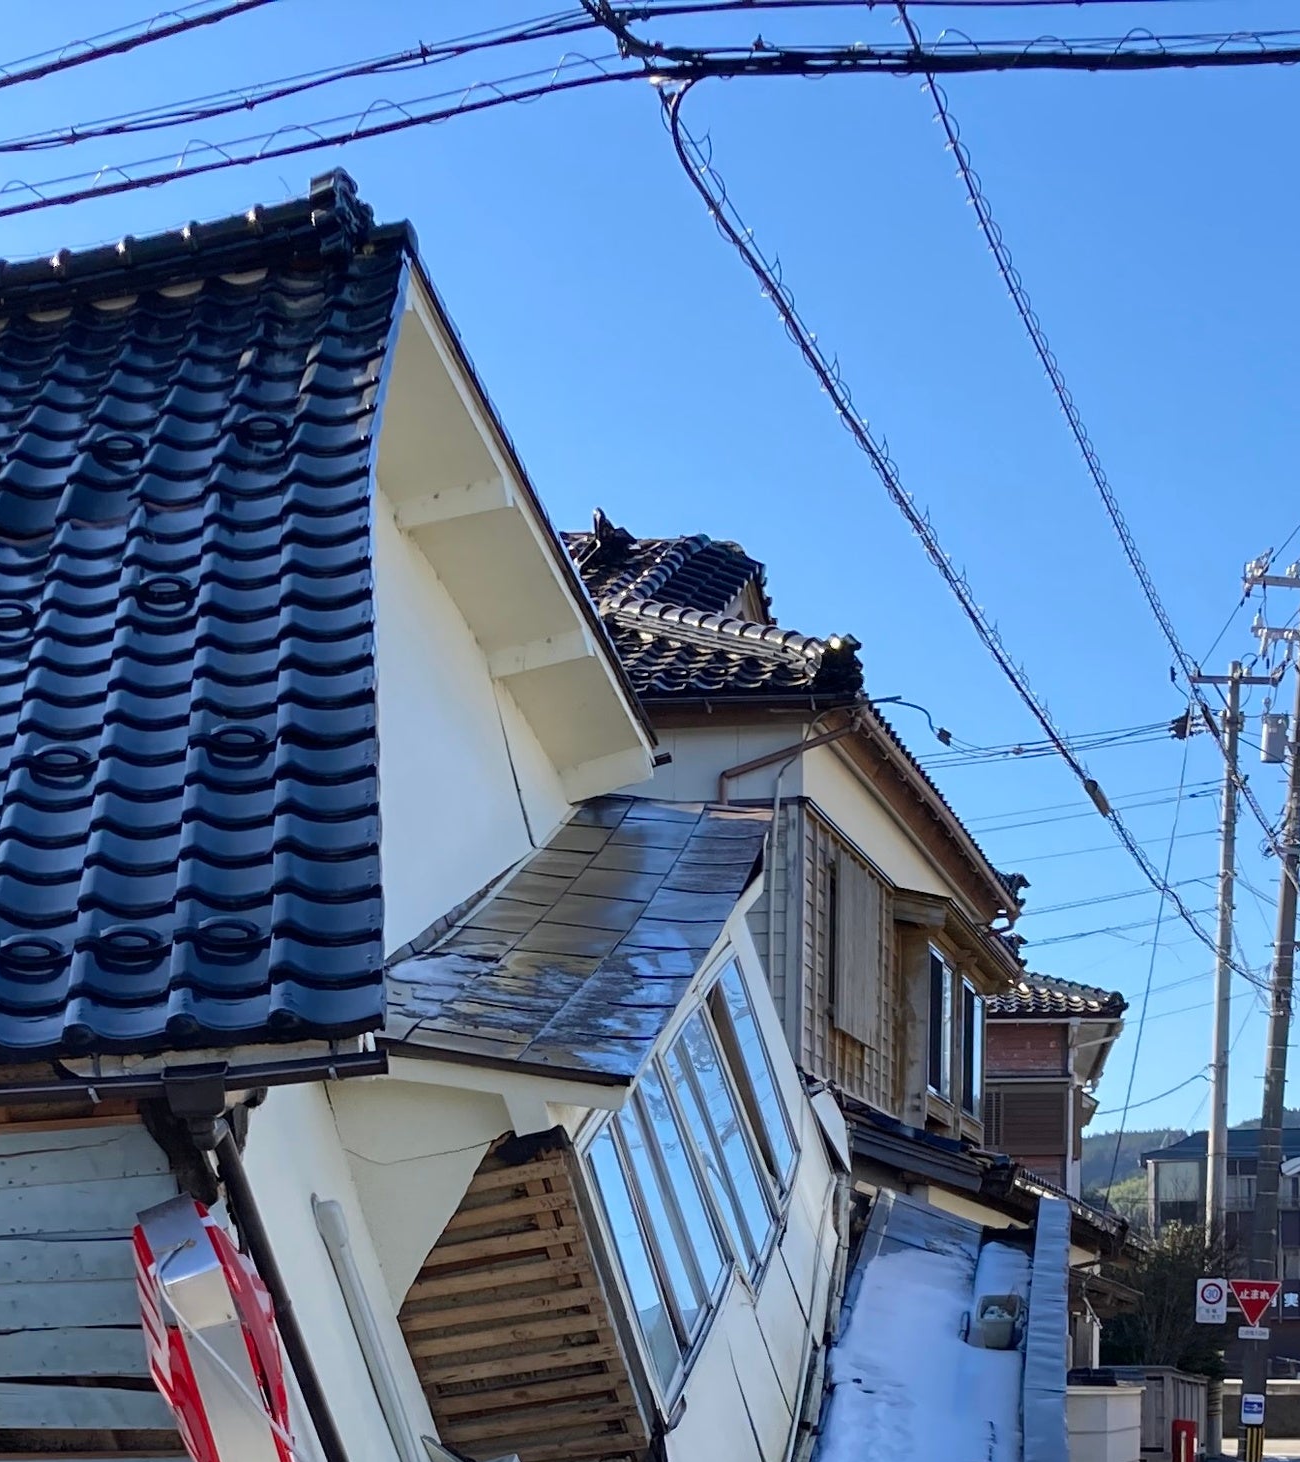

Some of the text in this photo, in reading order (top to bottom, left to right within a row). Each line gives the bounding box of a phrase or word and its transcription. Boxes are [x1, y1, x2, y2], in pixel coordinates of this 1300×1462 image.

[1206, 1288, 1219, 1300] 30
[1239, 1288, 1271, 1300] 止まれ
